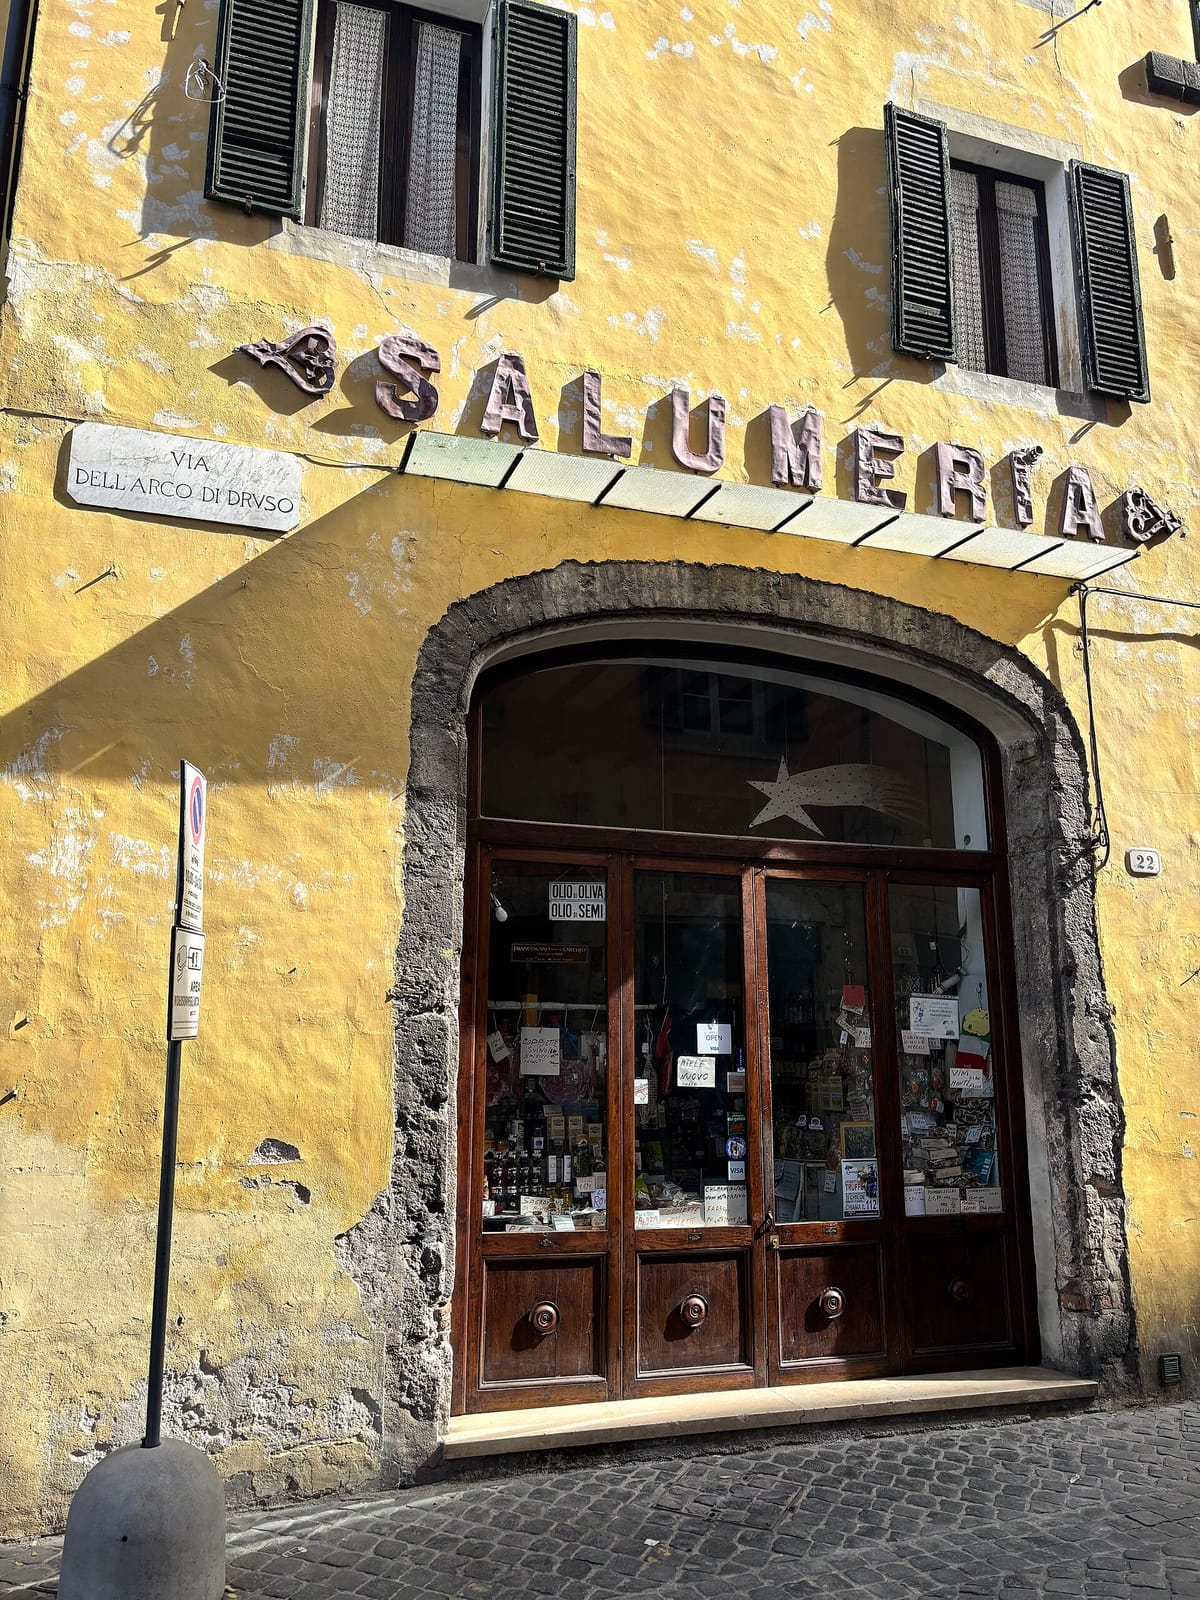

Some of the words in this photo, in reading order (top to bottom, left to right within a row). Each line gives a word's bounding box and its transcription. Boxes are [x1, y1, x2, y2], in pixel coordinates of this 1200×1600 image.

[375, 334, 1107, 542] SALUMERIA
[170, 451, 209, 472] VIA
[202, 486, 219, 504] DI
[228, 490, 294, 514] DRVSO
[1136, 854, 1154, 870] 22
[552, 884, 573, 899] OLIO
[578, 884, 604, 899] OLIVA
[551, 903, 572, 918] OLIO
[578, 903, 603, 919] SEMI
[705, 1034, 723, 1042] OPEN
[680, 1059, 704, 1068] MIELE
[679, 1072, 709, 1081] NUOVO
[866, 1200, 877, 1210] 112
